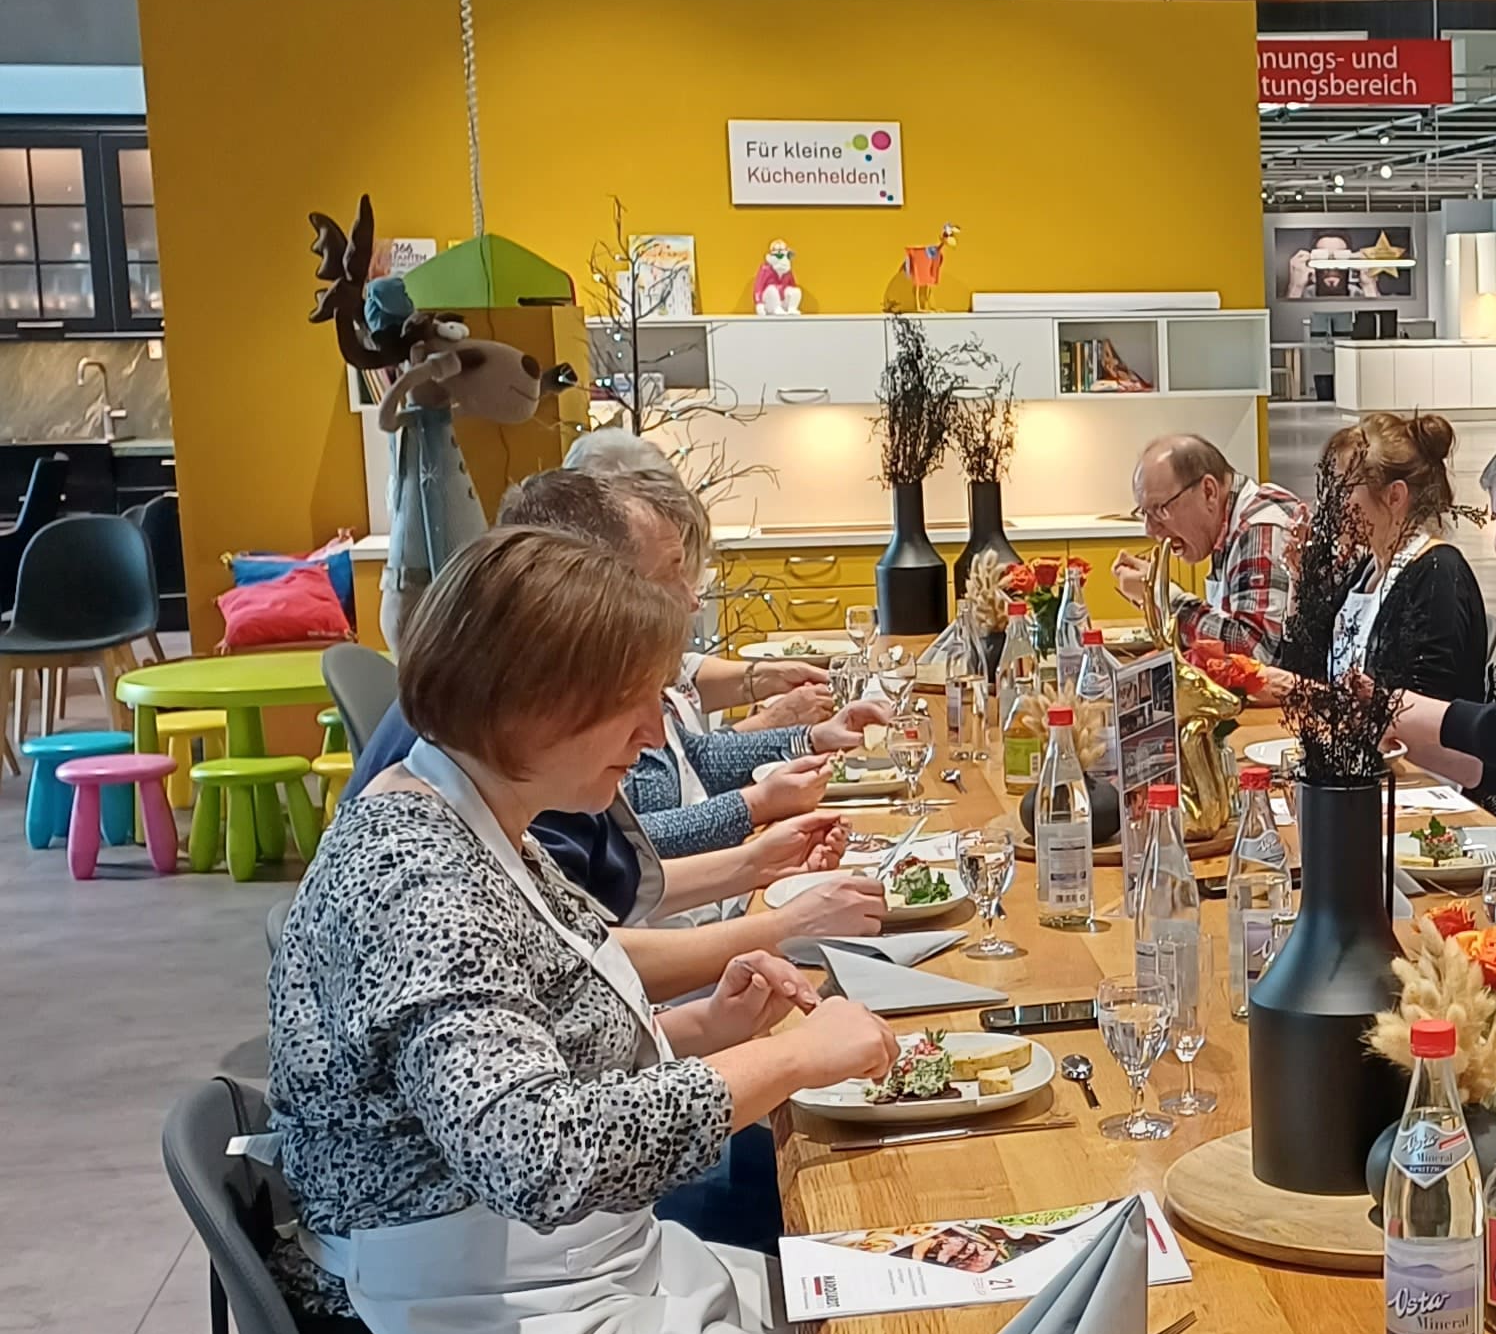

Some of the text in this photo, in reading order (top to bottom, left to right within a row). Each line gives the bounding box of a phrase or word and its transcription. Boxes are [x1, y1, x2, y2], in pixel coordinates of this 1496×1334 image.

[1256, 45, 1399, 75] nungs- und
[1261, 72, 1418, 102] tungsbereich
[746, 140, 842, 159] Für kleine
[747, 166, 886, 185] Küchenhelden!
[988, 1278, 1016, 1291] 21
[1388, 1287, 1450, 1318] Osta
[1416, 1314, 1469, 1331] Mineral
